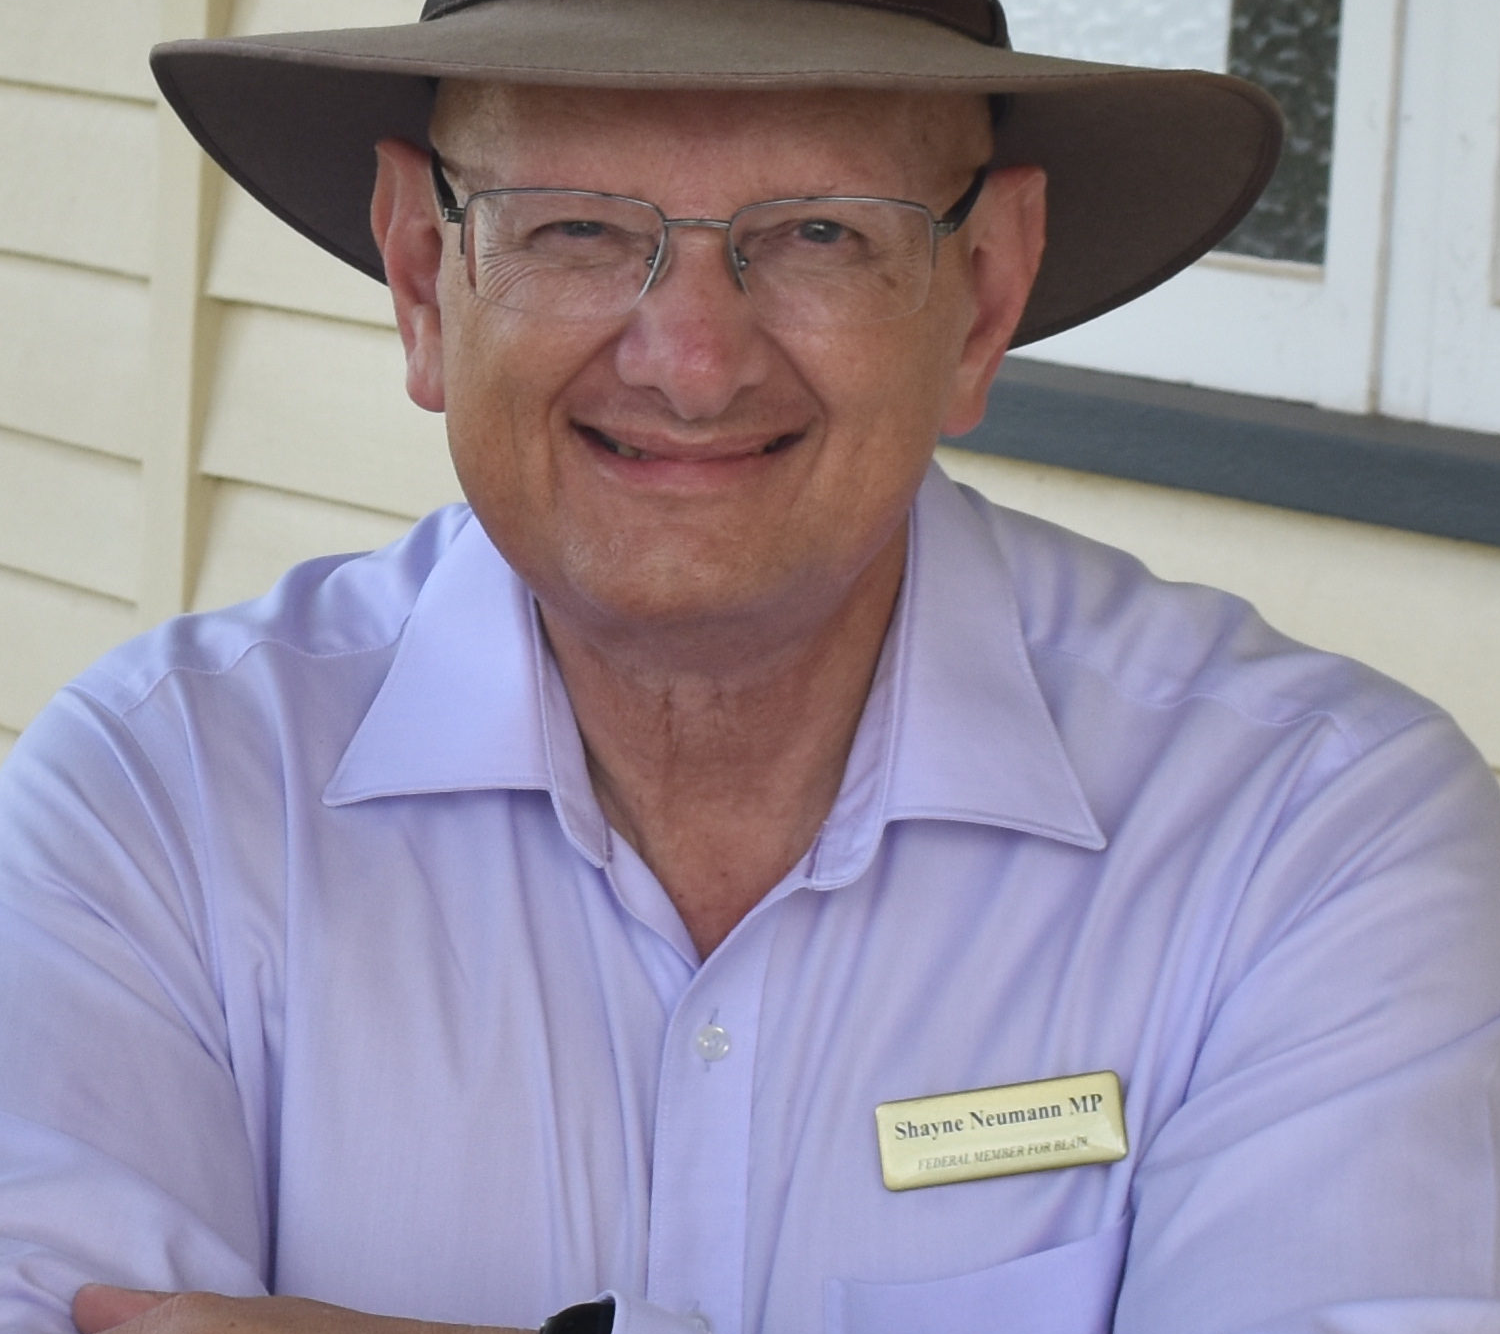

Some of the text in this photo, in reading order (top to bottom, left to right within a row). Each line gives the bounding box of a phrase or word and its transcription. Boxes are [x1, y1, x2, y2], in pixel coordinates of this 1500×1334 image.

[894, 1093, 1104, 1141] Shayne Neumann MP
[917, 1153, 970, 1172] FEDERAL
[973, 1144, 1025, 1163] MEMBER
[1027, 1140, 1051, 1157] FOR
